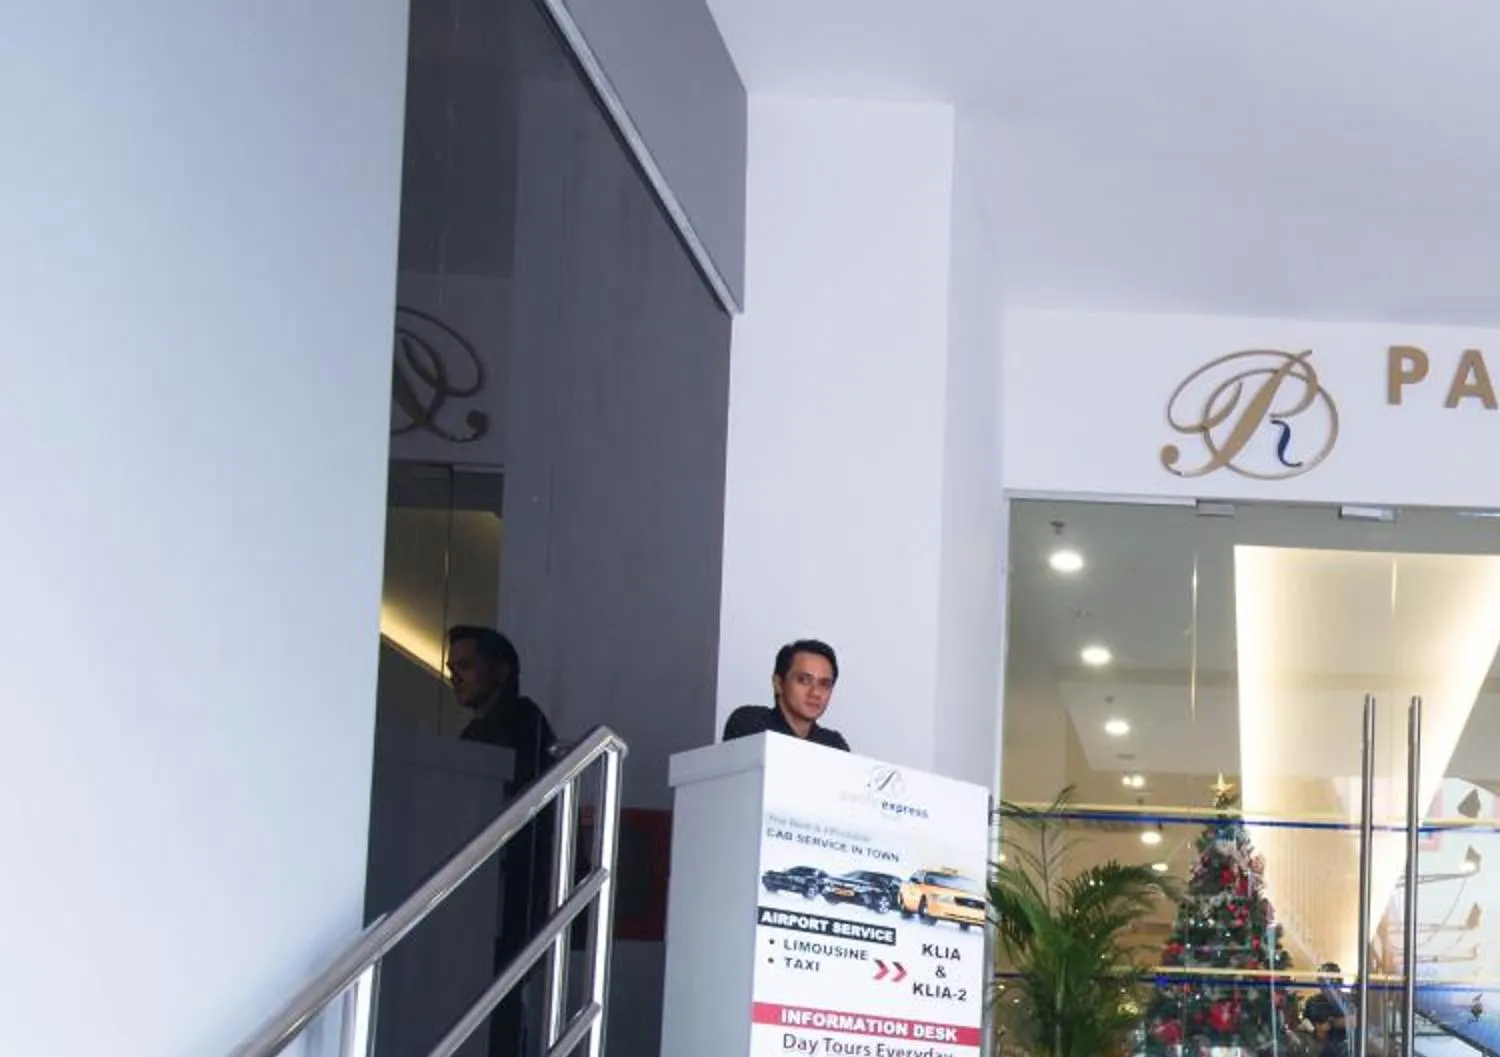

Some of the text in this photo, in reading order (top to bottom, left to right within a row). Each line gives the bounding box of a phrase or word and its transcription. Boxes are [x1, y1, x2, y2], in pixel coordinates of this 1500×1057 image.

[797, 833, 848, 853] SERVICE
[851, 844, 863, 855] IN
[866, 848, 899, 863] TOWN
[760, 911, 894, 942] AIRPORT SERVICE
[784, 939, 869, 960] LIMOUSINE
[921, 943, 961, 960] KLIA
[784, 957, 820, 971] TAXI
[935, 965, 946, 978] &
[912, 982, 967, 1001] KLIA-2
[781, 1008, 958, 1041] INFORMATION DESK
[783, 1034, 818, 1056] Day
[824, 1037, 871, 1057] Tours
